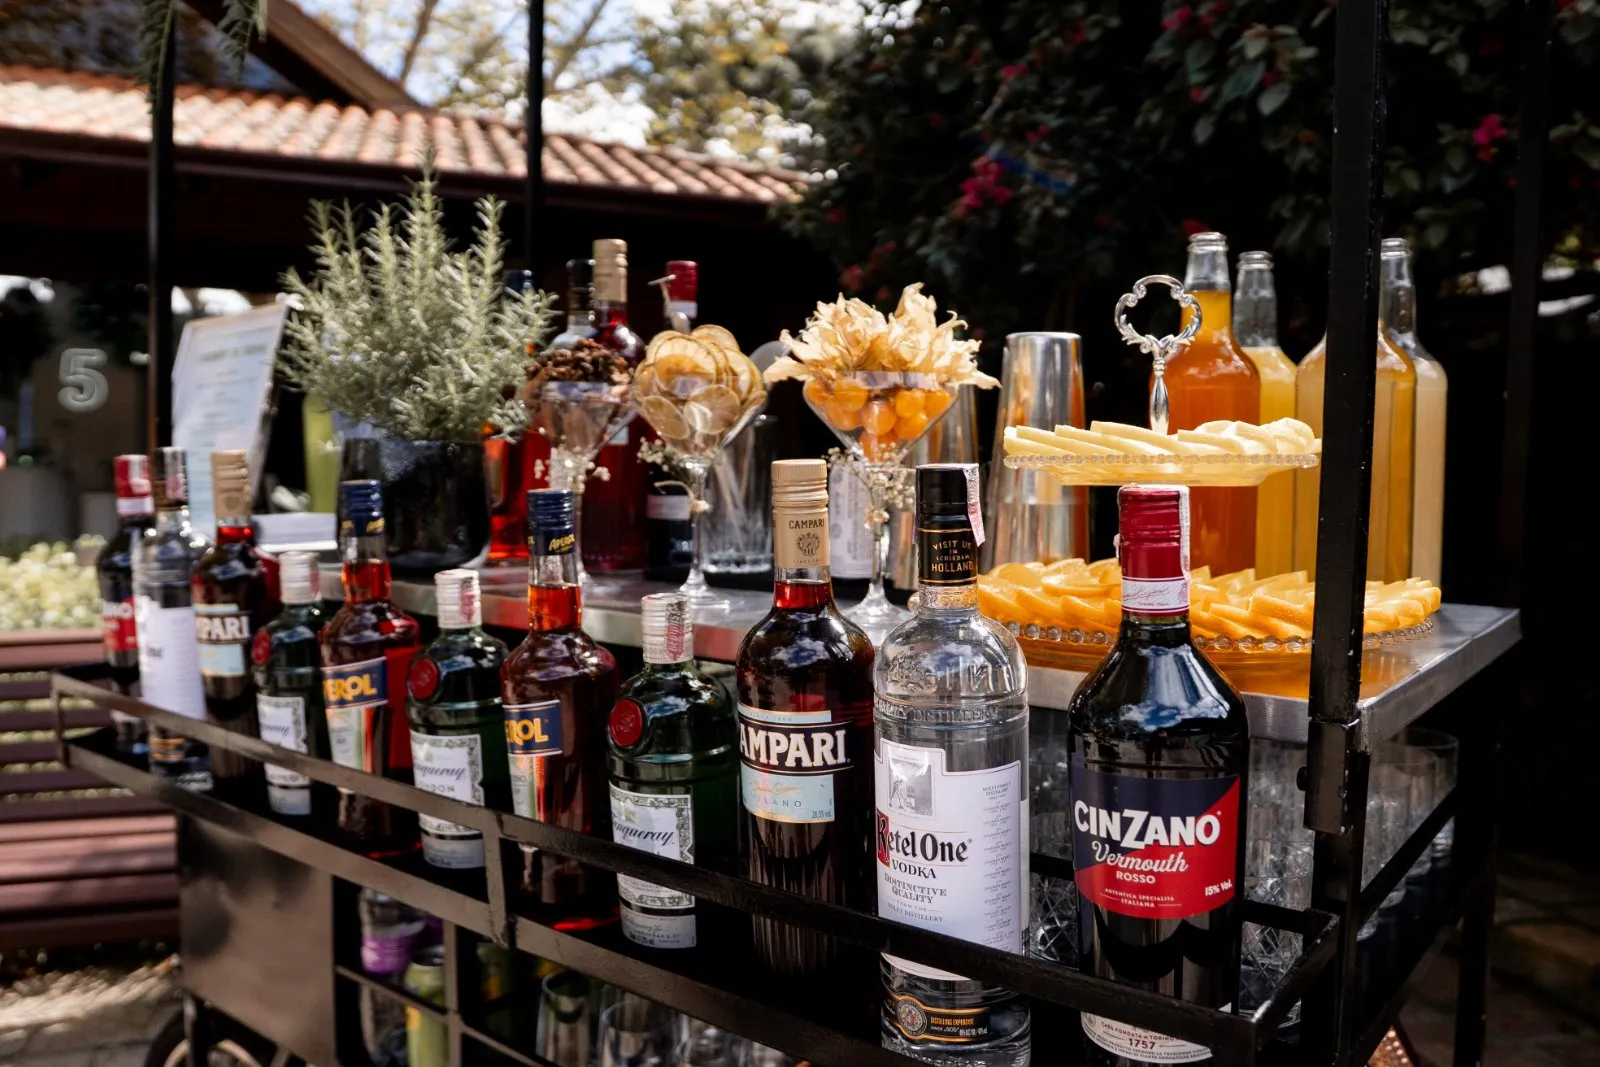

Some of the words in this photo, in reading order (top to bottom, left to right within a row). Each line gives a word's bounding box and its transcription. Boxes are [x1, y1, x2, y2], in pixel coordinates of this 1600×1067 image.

[57, 348, 109, 413] 5
[789, 518, 825, 529] CAMPARI
[933, 540, 958, 550] VISIT
[931, 560, 974, 573] HOLLAND
[323, 674, 378, 701] EROL
[1074, 800, 1221, 850] CINZANO
[920, 832, 968, 863] One
[1092, 841, 1189, 873] Vermouth
[892, 858, 937, 879] VODKA
[1116, 870, 1156, 884] ROSSO
[884, 872, 948, 897] DISTINCTIVE
[891, 885, 934, 904] QUALITY
[1105, 888, 1137, 899] AUTENTICA
[1121, 898, 1155, 908] ITALIANA
[904, 910, 944, 922] DISTILLERY
[1115, 1027, 1143, 1039] FONDATA
[1128, 1037, 1156, 1051] 1757
